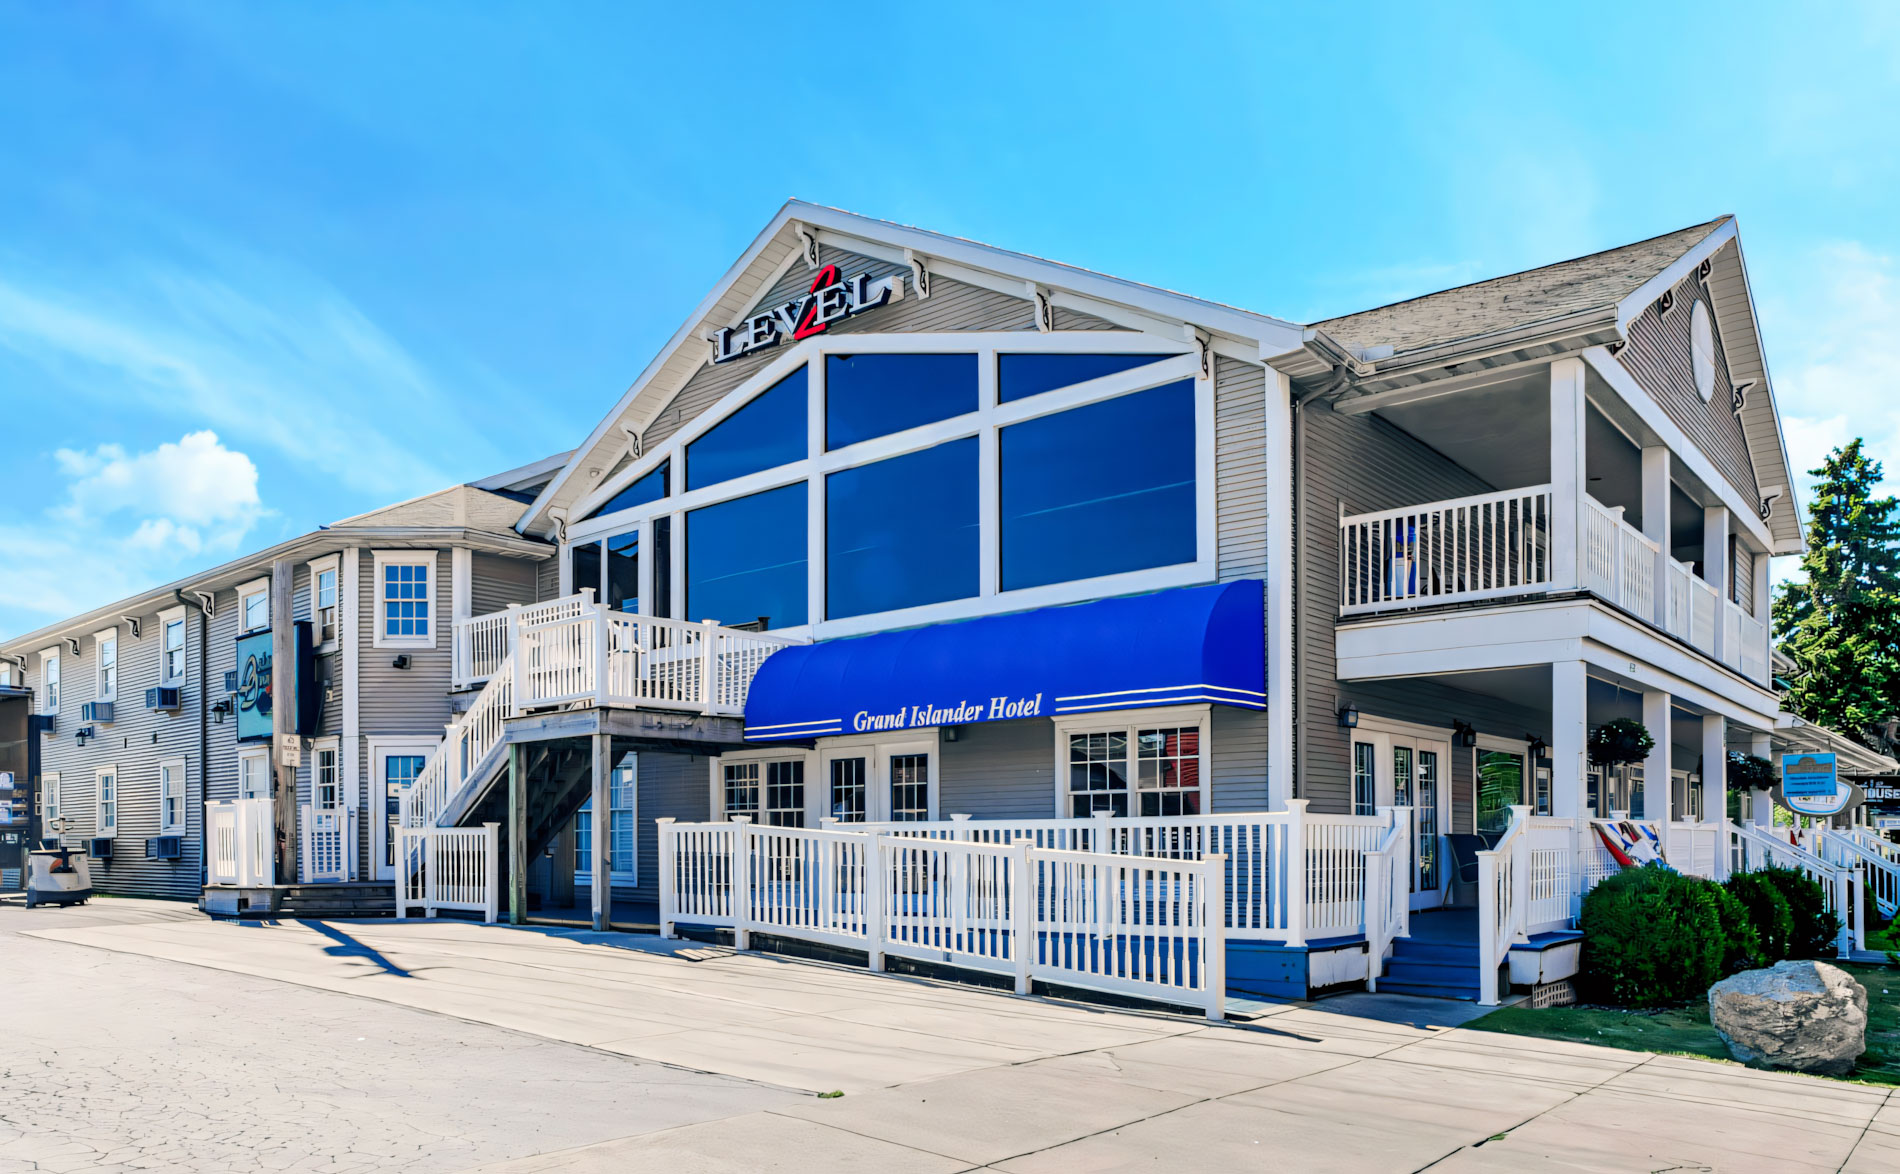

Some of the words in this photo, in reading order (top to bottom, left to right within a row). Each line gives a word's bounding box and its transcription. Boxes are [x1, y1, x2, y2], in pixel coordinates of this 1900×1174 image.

[714, 272, 893, 364] LEVEL
[853, 706, 907, 732] Grand
[909, 699, 984, 728] Islander
[987, 692, 1043, 720] Hotel
[1863, 788, 1900, 799] OUSE
